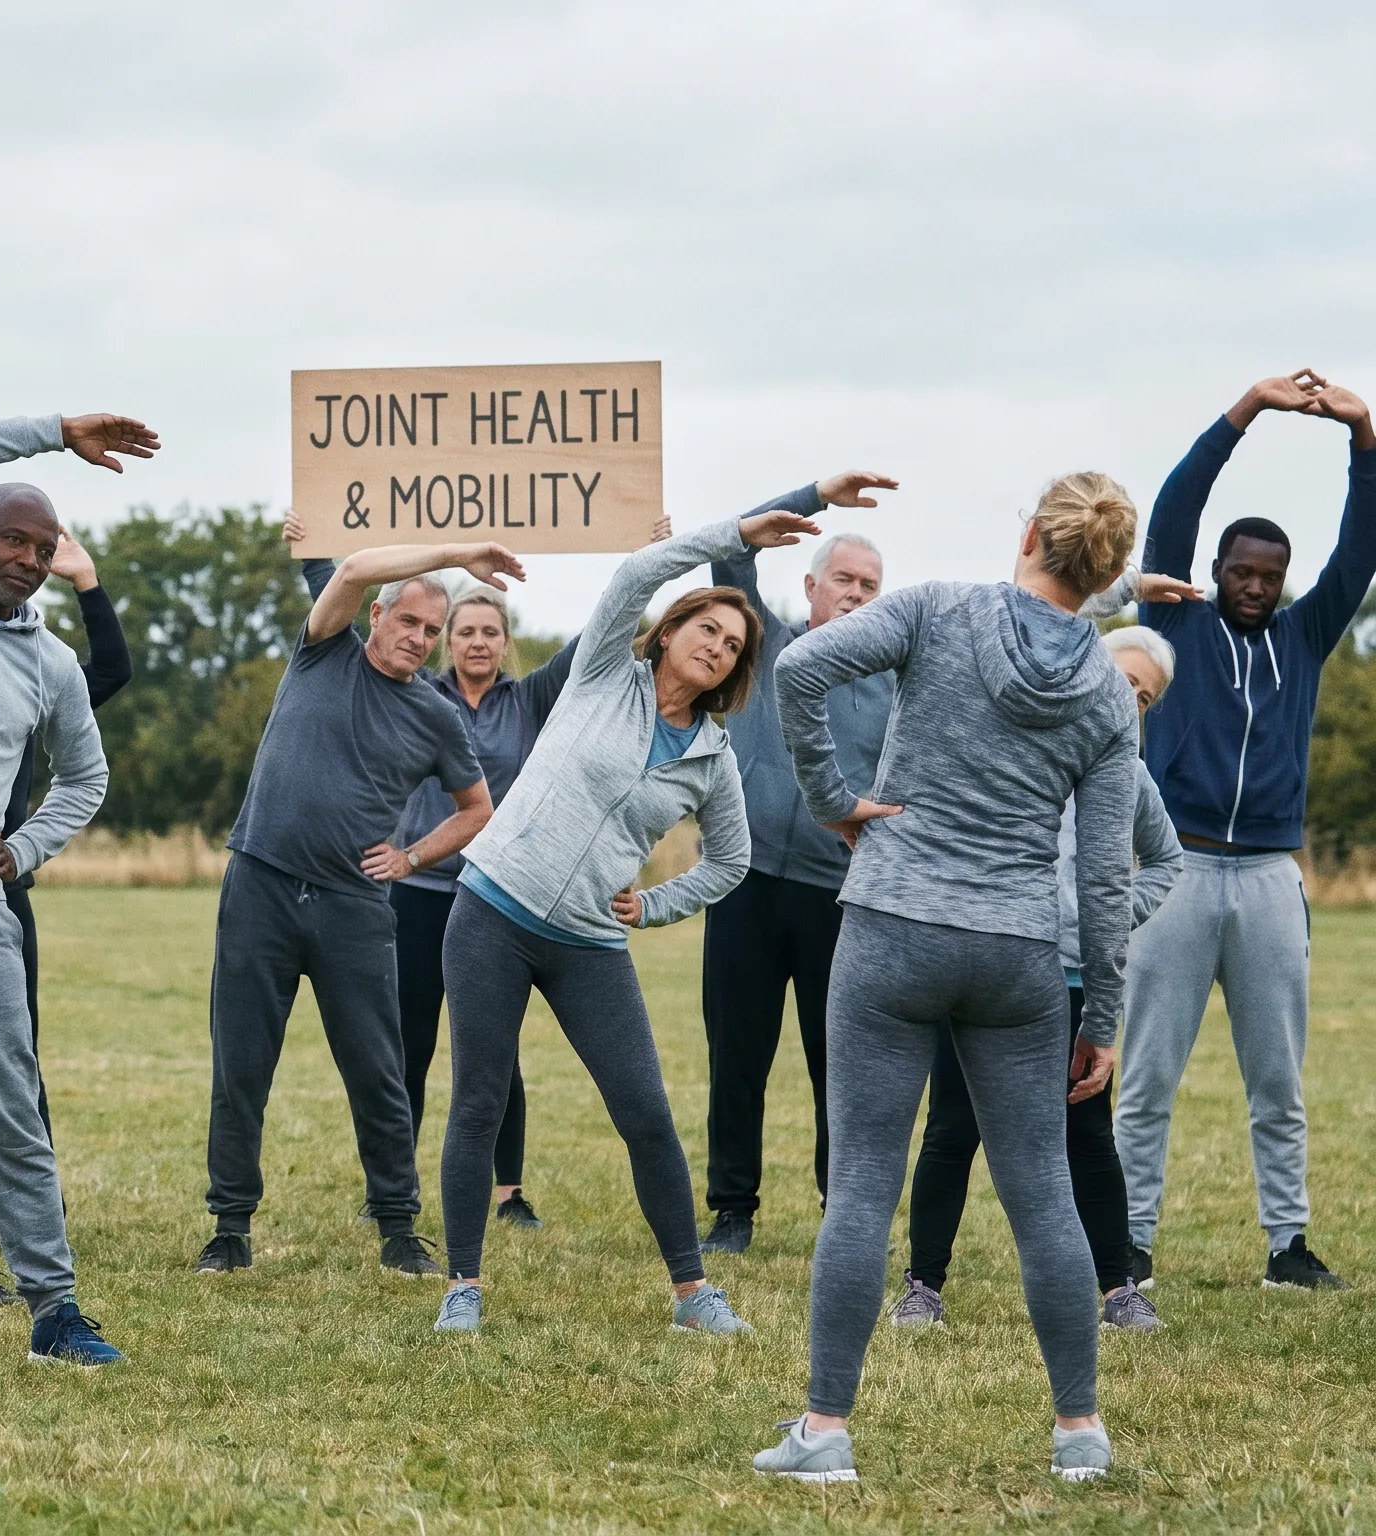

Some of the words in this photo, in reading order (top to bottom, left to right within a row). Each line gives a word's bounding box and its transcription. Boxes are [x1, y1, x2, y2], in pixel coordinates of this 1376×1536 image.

[309, 391, 449, 449] JOINT
[470, 387, 639, 445] HEALTH
[342, 481, 371, 529] &
[390, 472, 602, 529] MOBILITY
